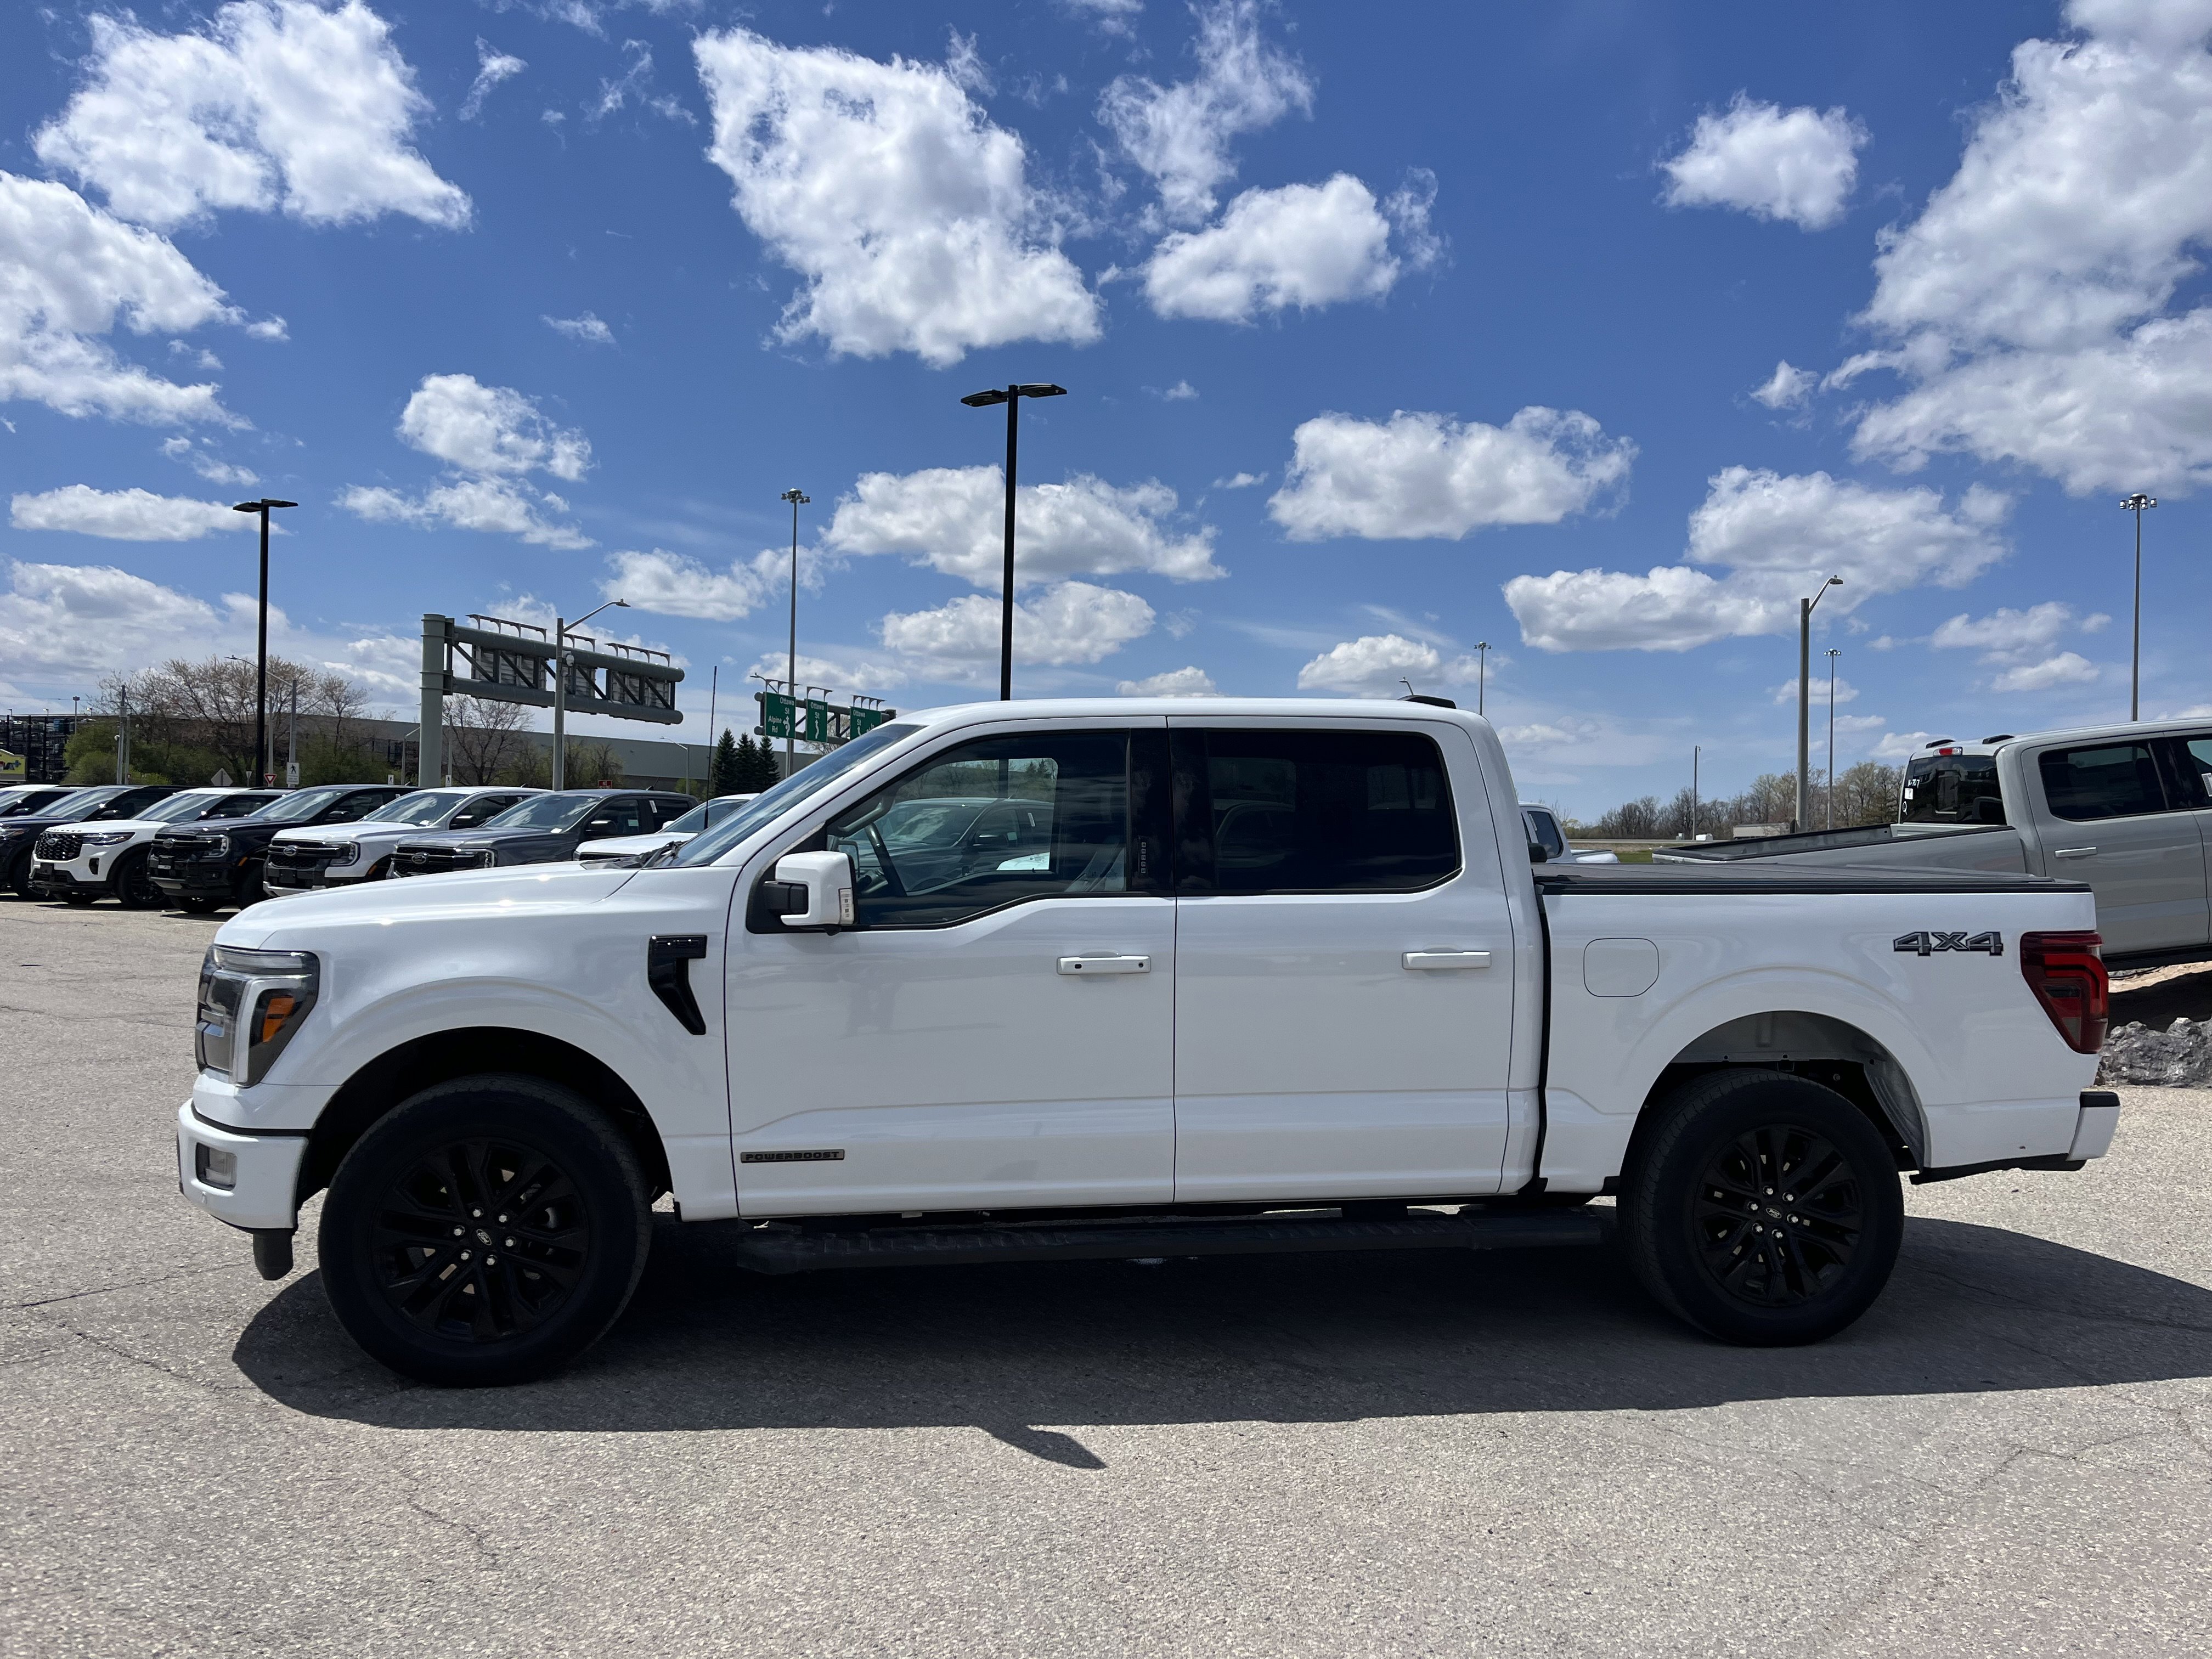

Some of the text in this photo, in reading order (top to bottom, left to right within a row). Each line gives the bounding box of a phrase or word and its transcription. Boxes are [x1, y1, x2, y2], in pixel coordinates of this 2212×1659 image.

[780, 697, 794, 706] Ottawa
[810, 702, 824, 710] Ottawa
[768, 715, 782, 724] Alpine
[746, 1152, 839, 1161] POWERBOOST
[477, 1231, 490, 1244] Ford
